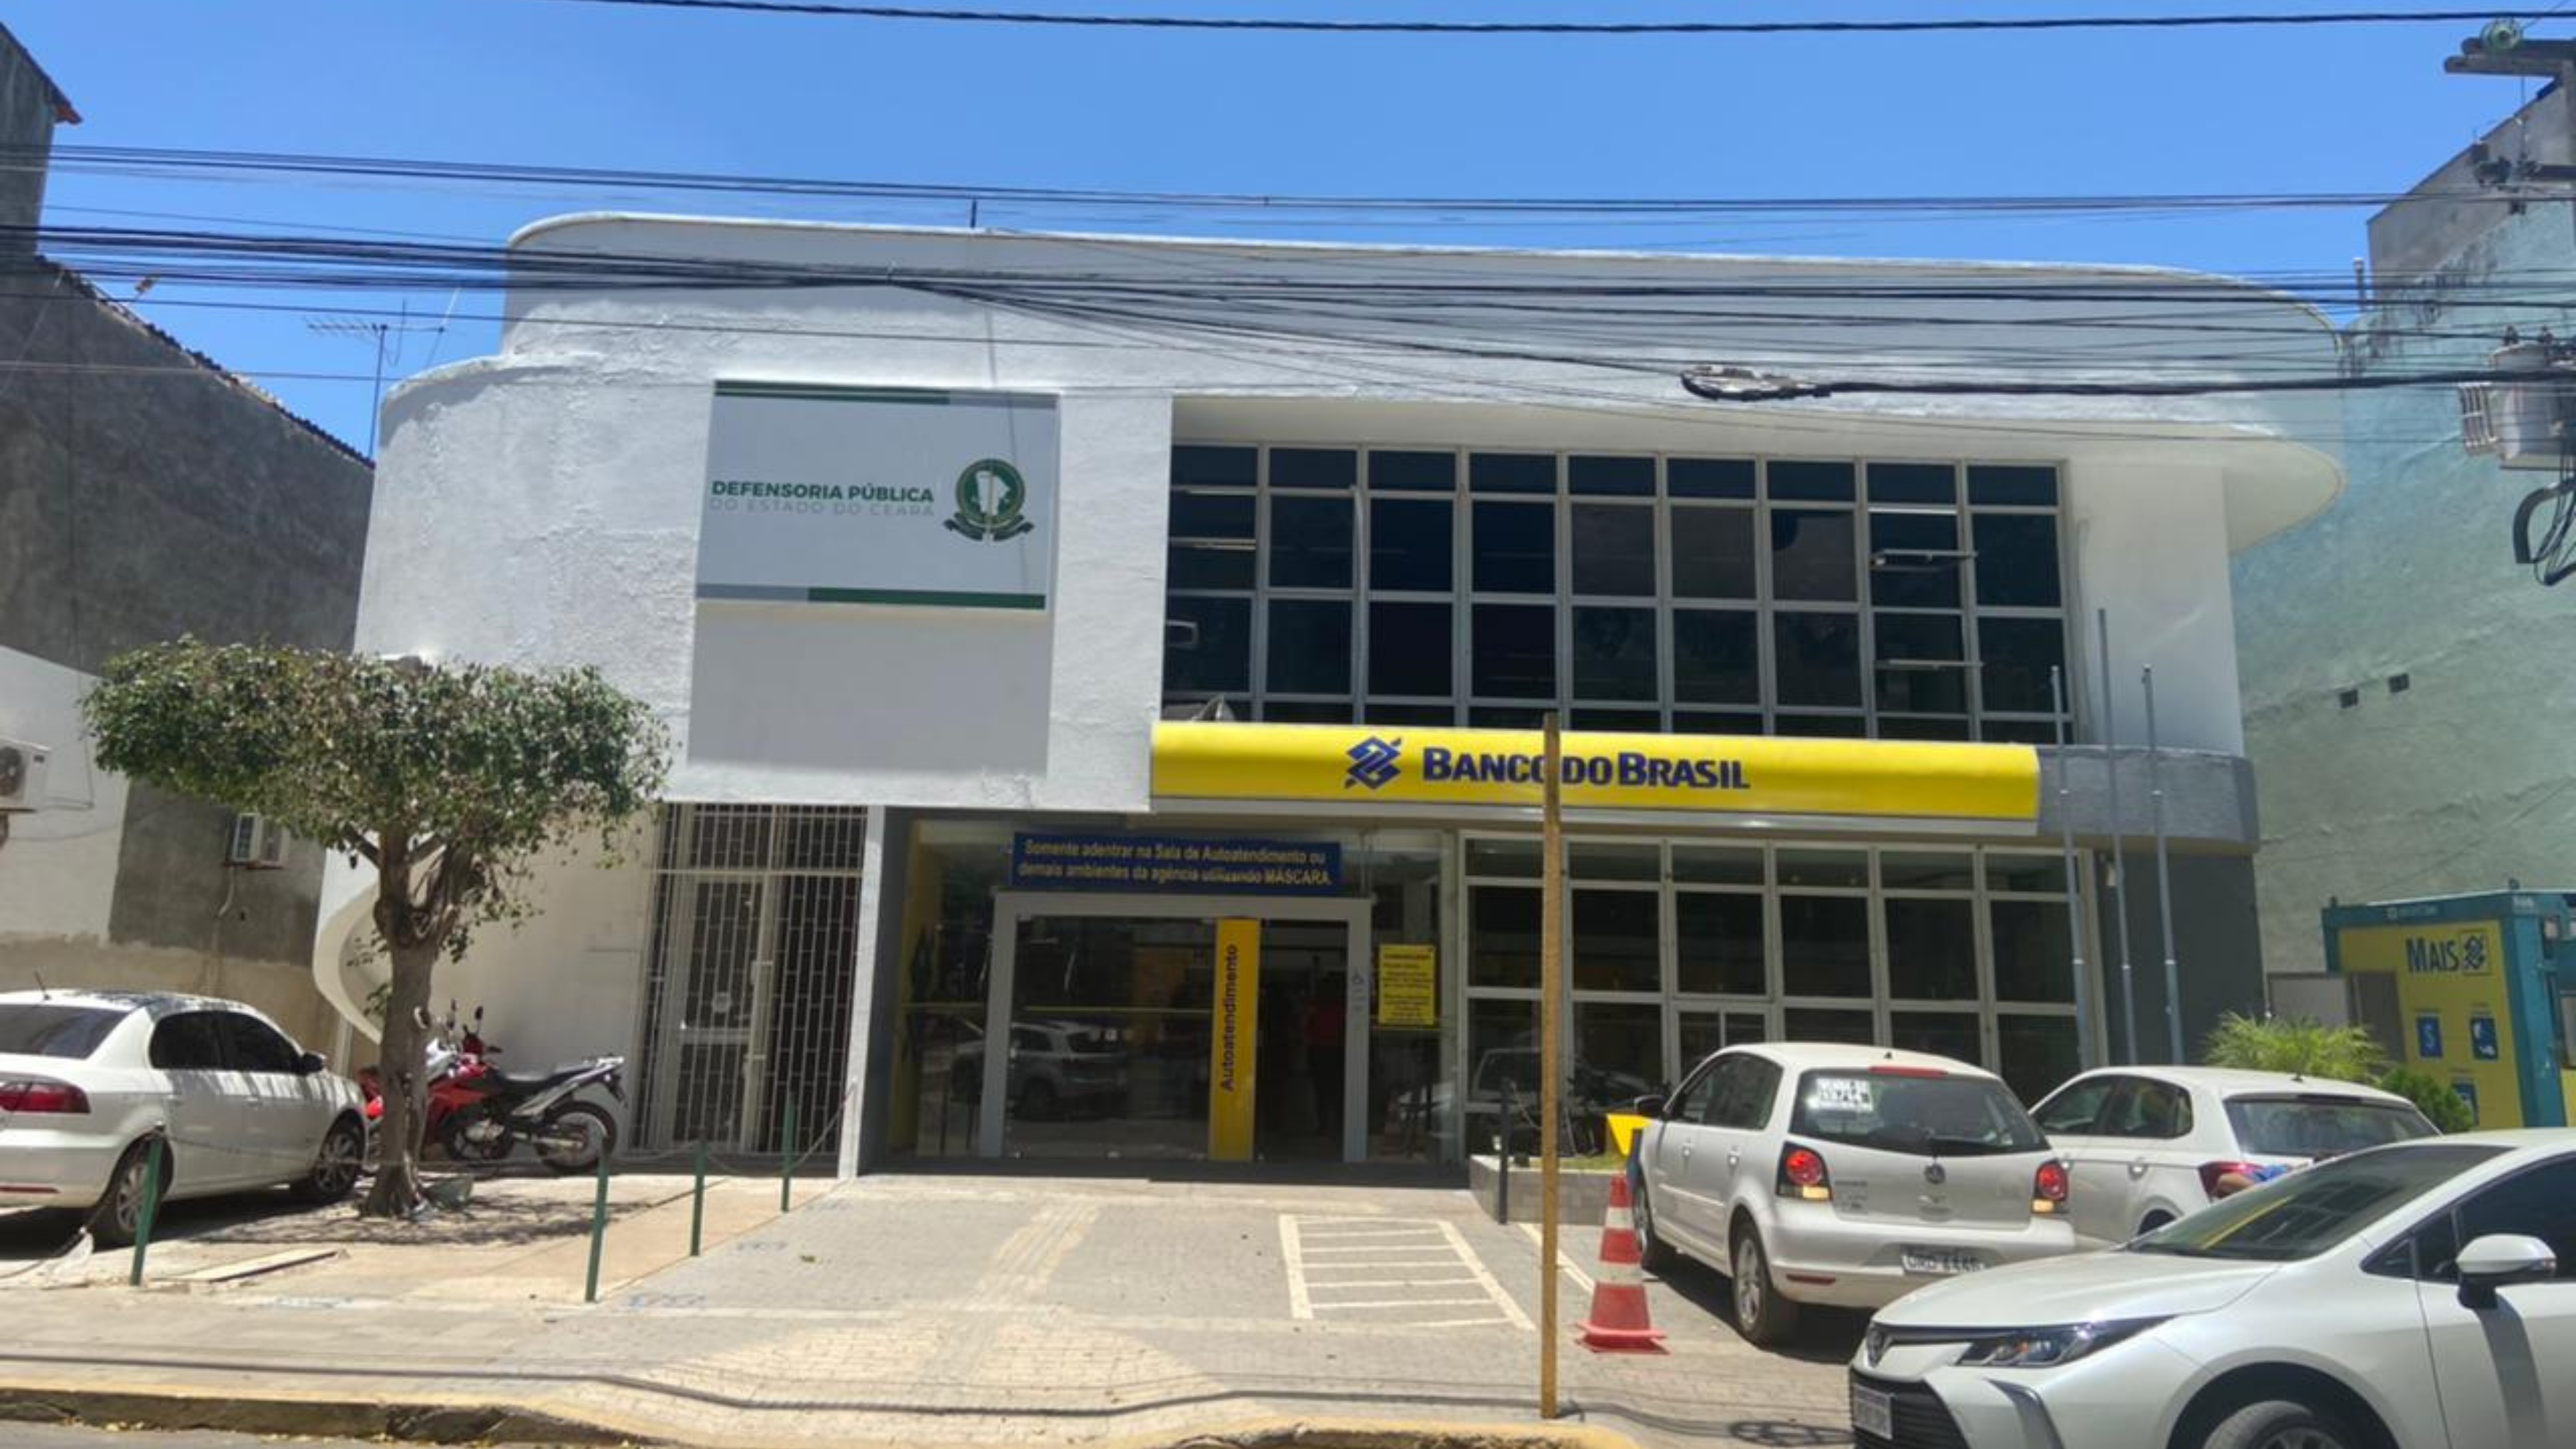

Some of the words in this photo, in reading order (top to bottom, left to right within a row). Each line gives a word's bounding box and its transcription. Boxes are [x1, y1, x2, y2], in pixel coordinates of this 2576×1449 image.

[712, 480, 842, 500] DEFENSORIA
[849, 483, 934, 502] PÚBLICA
[709, 498, 736, 512] DO
[746, 500, 823, 515] ESTADO
[834, 502, 860, 516] DO
[1562, 755, 1613, 786] DO
[1619, 752, 1750, 790] BRASIL
[1025, 839, 1079, 855] Somente
[1081, 841, 1132, 857] adentrar
[1135, 846, 1151, 858] na
[1155, 843, 1180, 859] Sala
[1184, 846, 1199, 860] de
[1202, 845, 1307, 863] Autoatendimento
[1309, 853, 1326, 864] ou
[1017, 862, 1063, 876] demais
[1066, 863, 1128, 877] ambientes
[1132, 865, 1148, 878] da
[1201, 868, 1262, 883] utilizando
[2406, 938, 2459, 973] MAIS
[1220, 945, 1238, 1091] Autoatendimento
